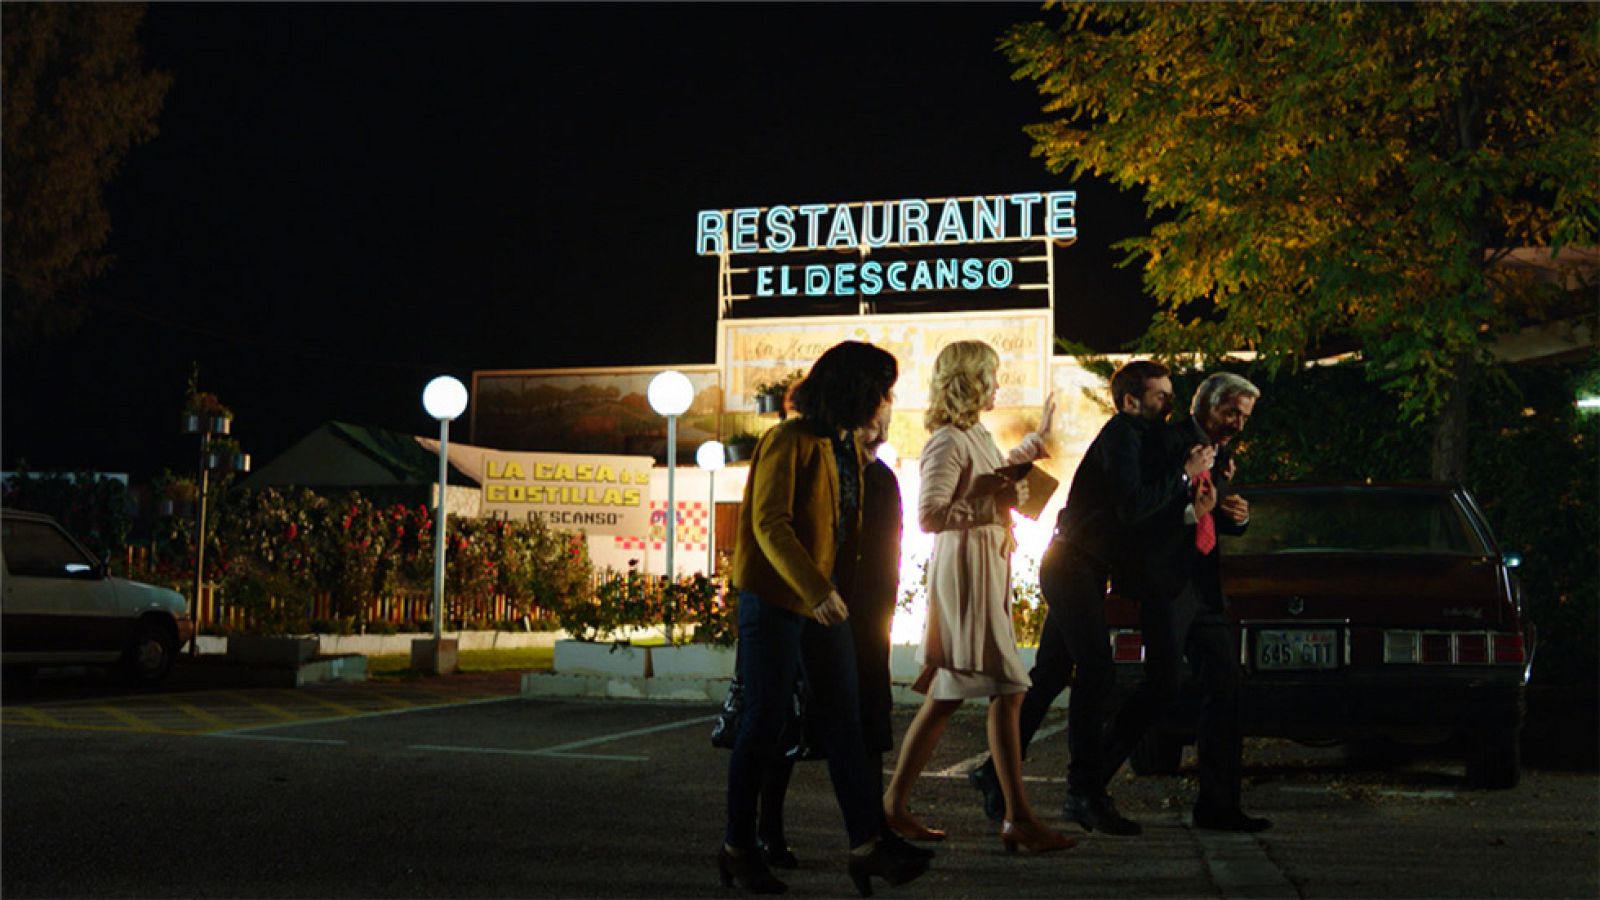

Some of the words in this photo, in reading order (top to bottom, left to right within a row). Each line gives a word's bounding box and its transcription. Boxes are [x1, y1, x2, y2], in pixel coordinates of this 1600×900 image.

[697, 191, 1077, 255] RESTAURANTE
[804, 258, 1014, 297] DESCANSO
[486, 459, 526, 480] LA
[533, 461, 617, 483] CASA
[486, 483, 641, 507] COSTILLAS
